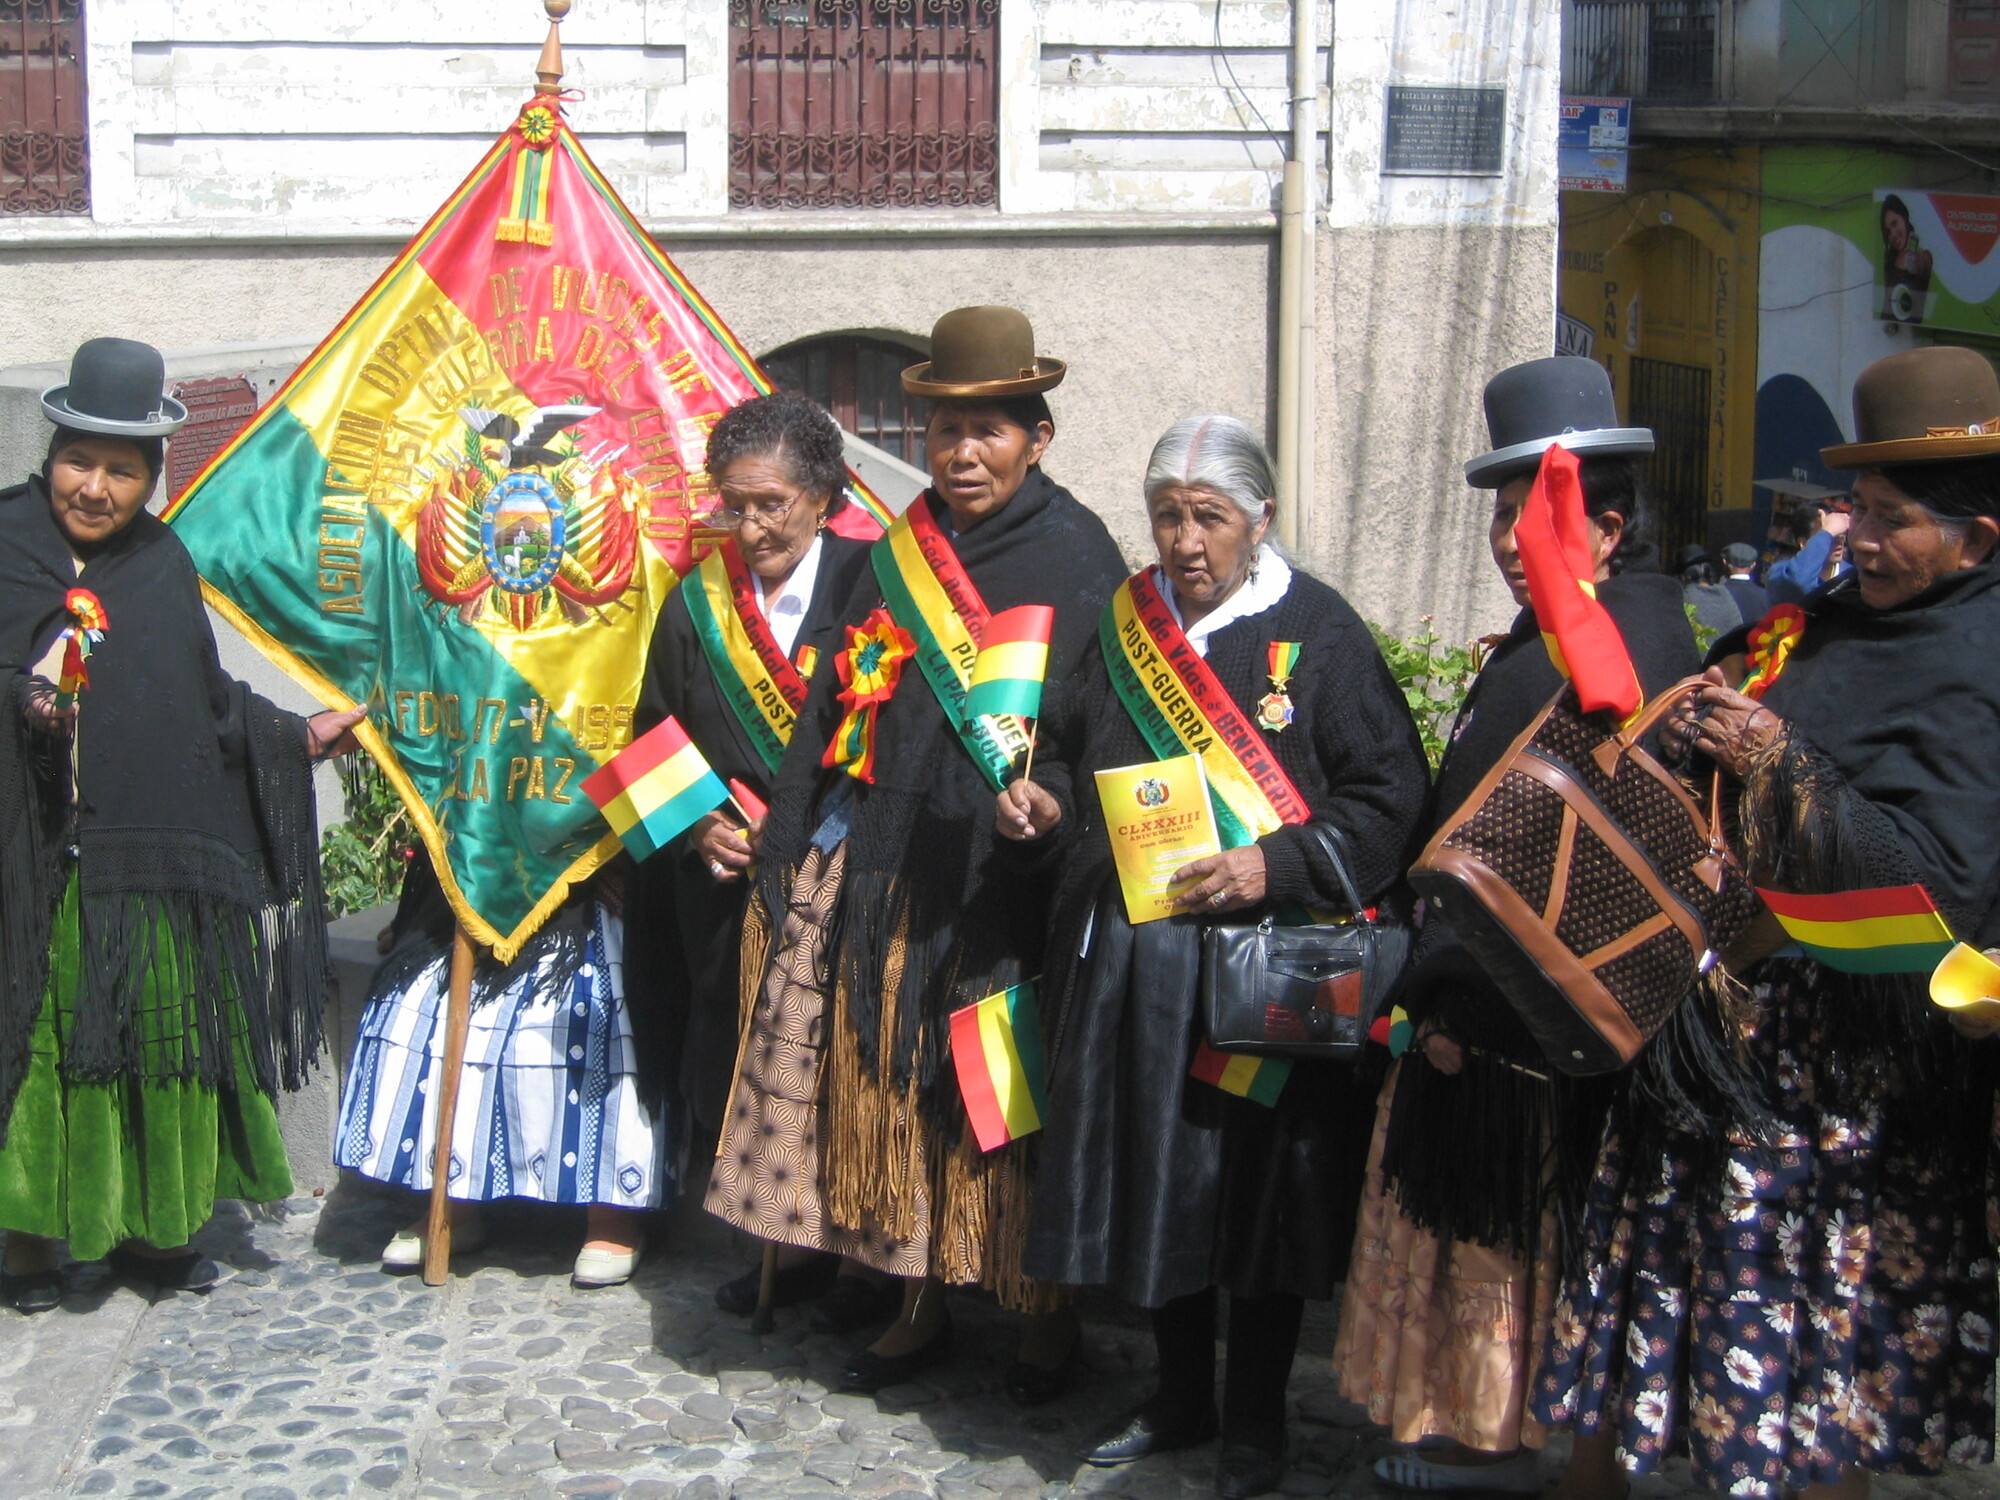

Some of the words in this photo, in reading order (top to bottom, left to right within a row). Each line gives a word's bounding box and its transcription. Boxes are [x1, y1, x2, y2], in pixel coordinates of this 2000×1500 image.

[1604, 282, 1618, 339] PAN
[317, 407, 386, 615] ASOCIACION
[359, 303, 470, 399] DPTAL
[489, 266, 527, 319] DE
[552, 265, 667, 352] VIUDAS
[653, 346, 713, 406] DE
[417, 315, 555, 412] GUERRA
[574, 324, 642, 401] DEL
[629, 407, 687, 540] CHACO
[926, 650, 950, 679] LA
[1106, 633, 1121, 663] LA
[1149, 616, 1171, 643] de
[1168, 643, 1210, 703] Vdas.
[734, 687, 755, 716] LA
[782, 684, 804, 711] de
[1122, 618, 1214, 755] POST-GUERRA
[454, 757, 490, 805] LA
[506, 755, 577, 805] PAZ
[1118, 811, 1201, 836] CLXXXIII
[1129, 824, 1194, 841] ANIVERSARIO
